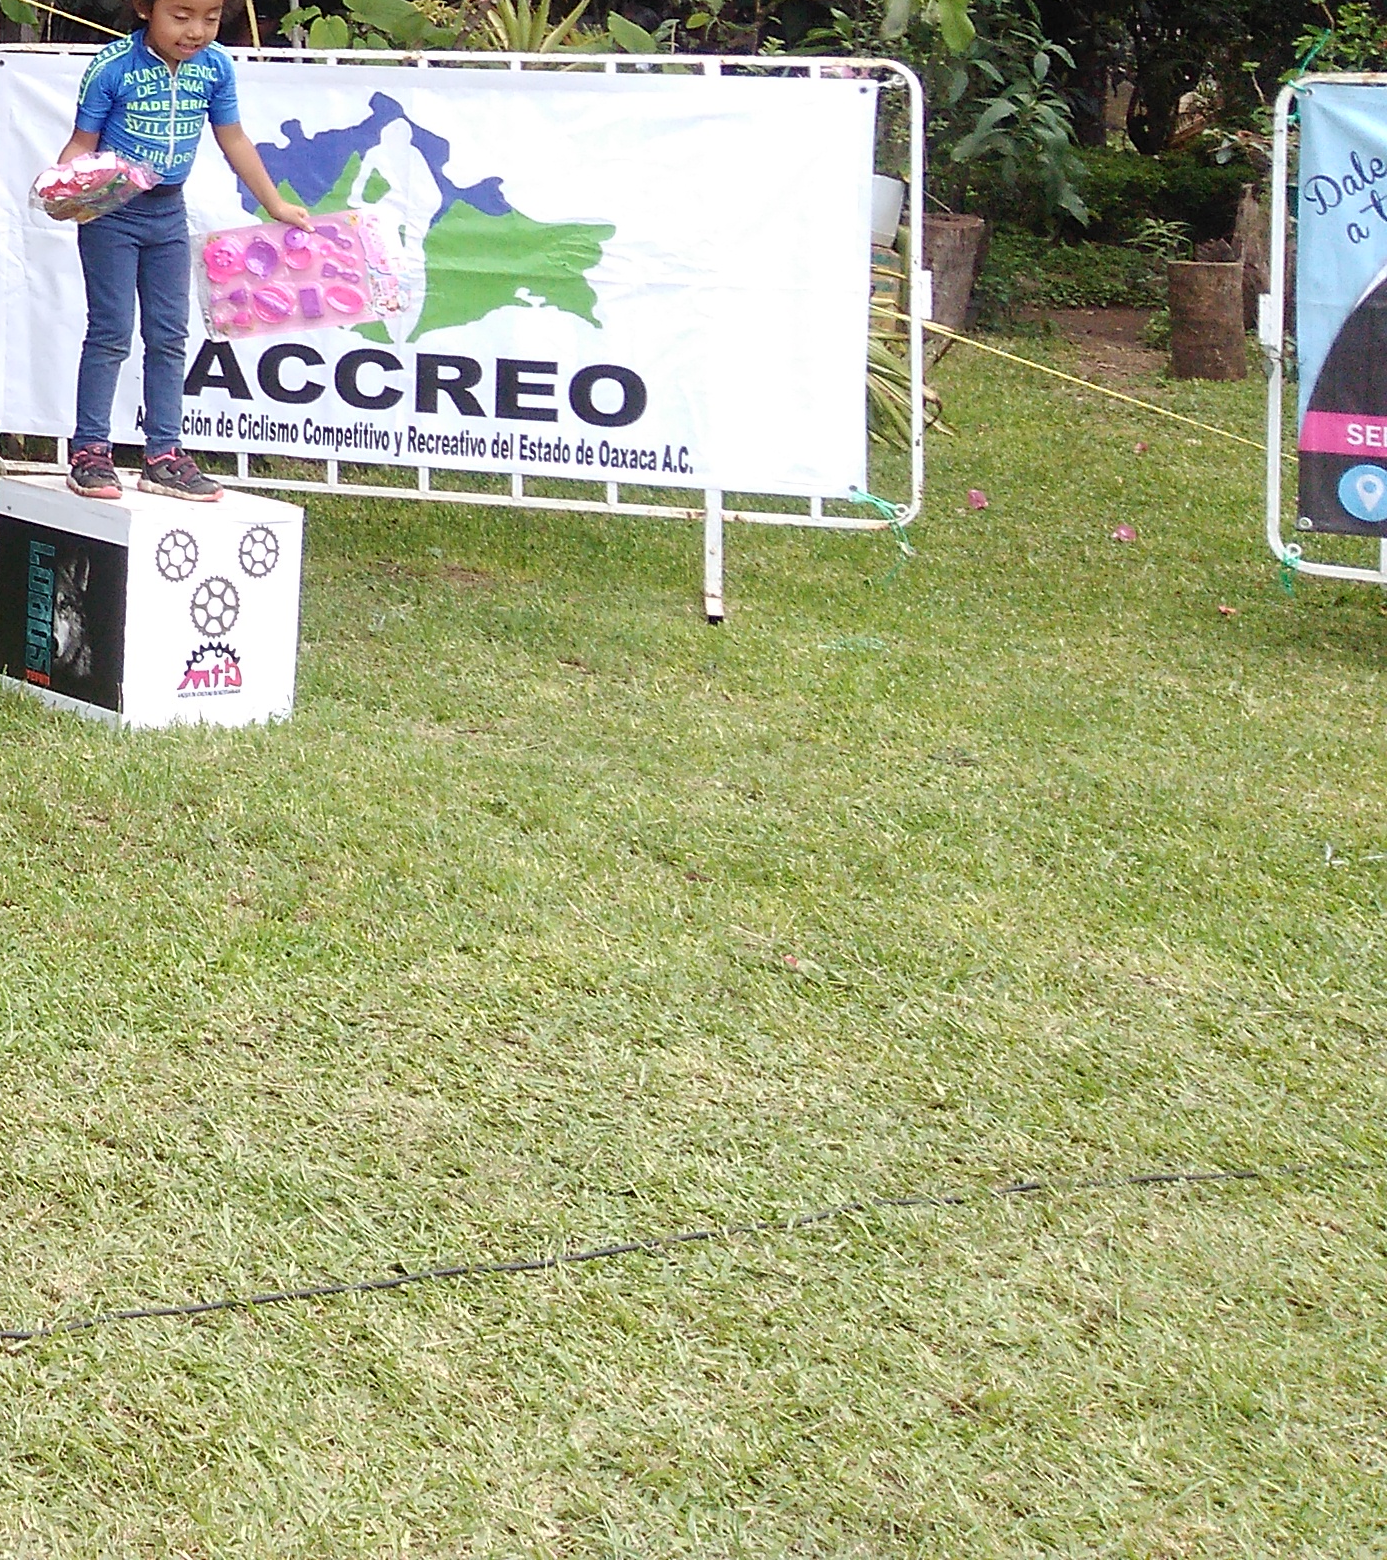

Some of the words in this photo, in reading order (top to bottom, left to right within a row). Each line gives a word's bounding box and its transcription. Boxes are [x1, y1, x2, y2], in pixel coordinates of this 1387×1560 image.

[136, 82, 158, 99] DE
[182, 338, 648, 428] ACCREO
[217, 411, 234, 438] de
[237, 413, 299, 443] Ciclismo
[303, 417, 390, 453] Competitivo
[393, 430, 403, 457] y
[407, 425, 487, 458] Recreativo
[491, 432, 514, 460] del
[519, 434, 571, 463] Estado
[576, 438, 595, 466] de
[598, 440, 658, 470] Oaxaca
[662, 444, 694, 475] A.C.
